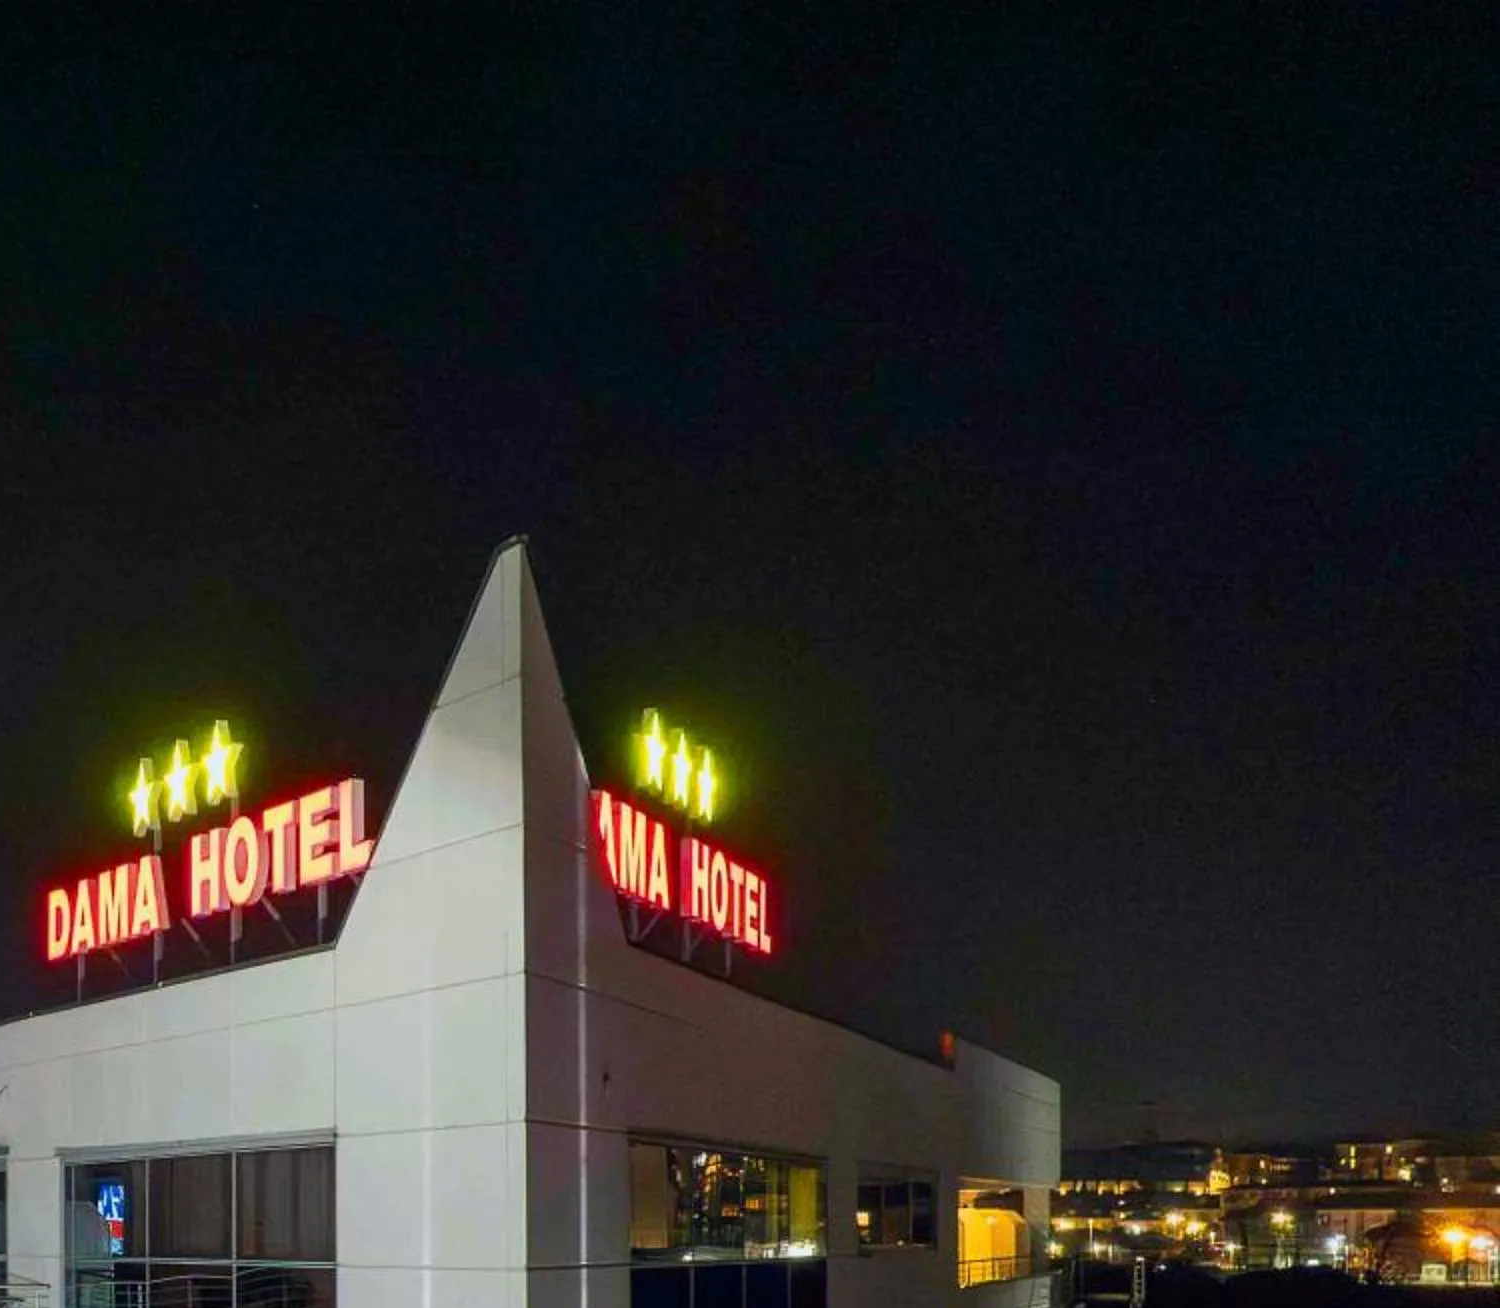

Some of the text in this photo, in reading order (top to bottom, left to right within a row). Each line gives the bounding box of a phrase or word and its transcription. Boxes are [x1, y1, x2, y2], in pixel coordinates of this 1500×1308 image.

[47, 777, 377, 961] DAMA HOTEL
[688, 837, 772, 954] HOTEL
